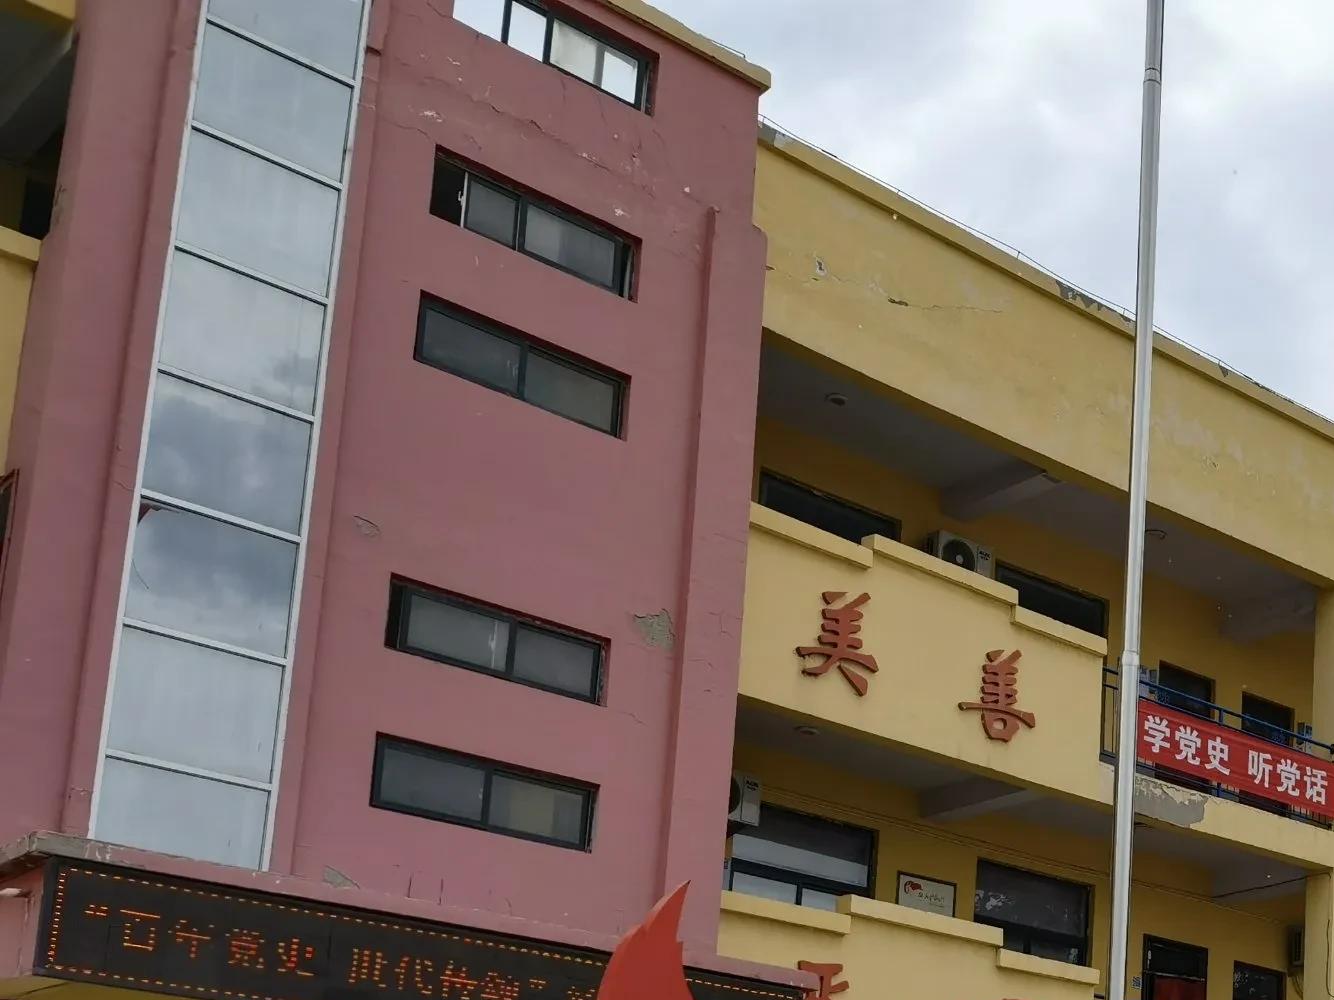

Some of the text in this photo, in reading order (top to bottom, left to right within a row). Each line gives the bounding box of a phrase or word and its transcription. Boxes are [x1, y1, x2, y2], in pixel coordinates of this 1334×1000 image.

[795, 590, 1036, 743] 美 善
[1143, 714, 1230, 776] 学党史
[1247, 749, 1329, 806] 听党话
